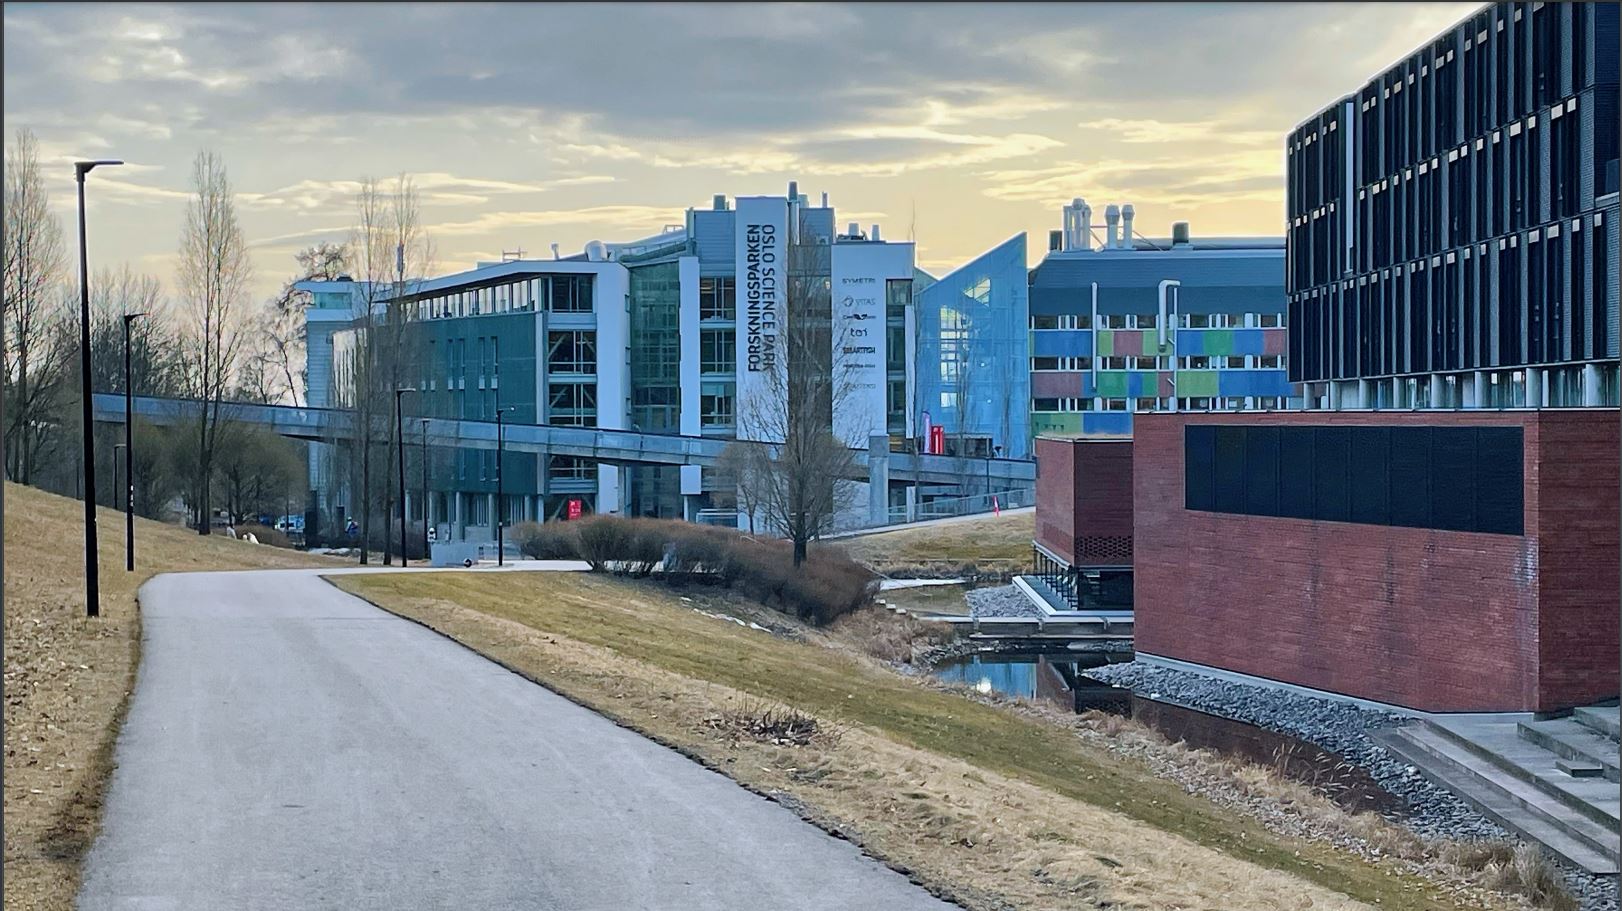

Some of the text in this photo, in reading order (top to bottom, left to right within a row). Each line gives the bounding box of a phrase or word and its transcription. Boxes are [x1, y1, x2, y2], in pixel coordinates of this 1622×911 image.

[747, 224, 760, 371] FORSKNINGSPARKEN
[762, 224, 775, 371] OSLO SCIENCE PARK
